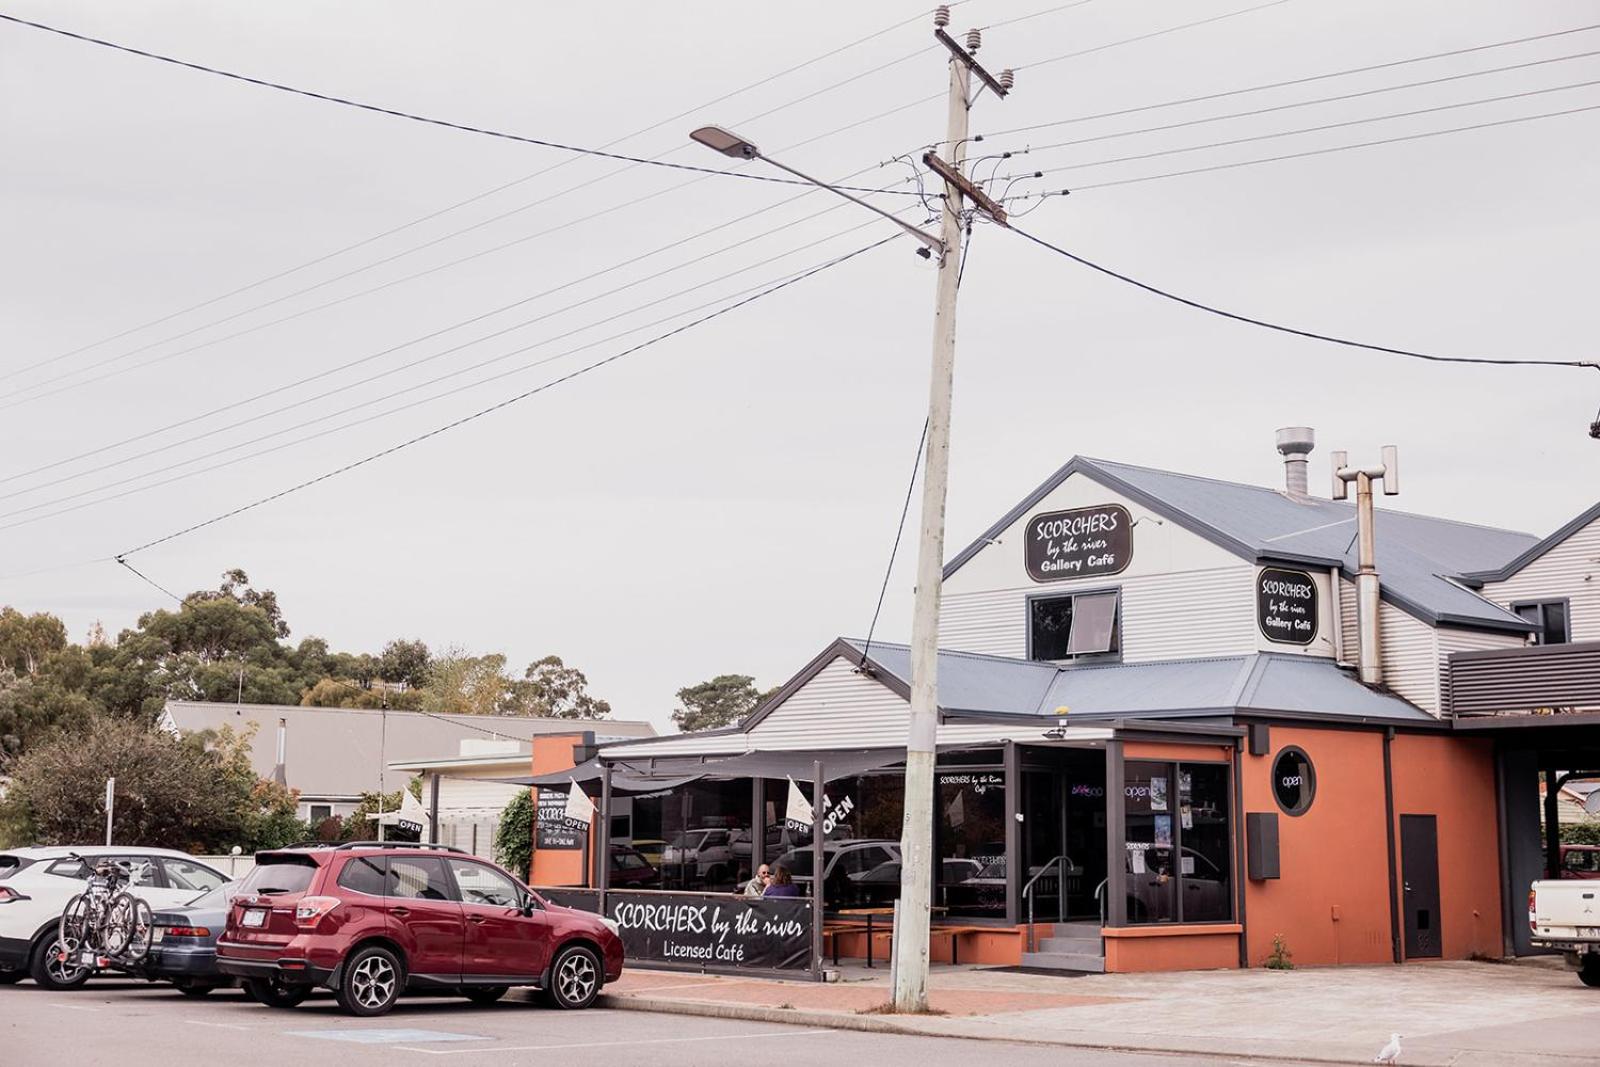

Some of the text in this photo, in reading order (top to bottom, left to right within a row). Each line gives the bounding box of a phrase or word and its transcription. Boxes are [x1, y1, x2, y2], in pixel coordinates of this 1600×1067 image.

[1036, 512, 1118, 540] SCORCHERS
[1046, 537, 1108, 560] by the river
[1041, 554, 1115, 572] Gallery Café
[1262, 579, 1312, 599] SCORCHERS
[1269, 599, 1306, 615] by the river
[1265, 616, 1311, 631] Gallery Café
[1282, 775, 1303, 789] open
[1125, 786, 1151, 798] open
[822, 794, 854, 835] OPEN
[399, 820, 421, 833] OPEN
[564, 817, 589, 831] OPEN
[787, 820, 809, 834] OPEN
[614, 902, 804, 943] SCORCHERS by the river
[663, 940, 744, 962] Licensed Café
